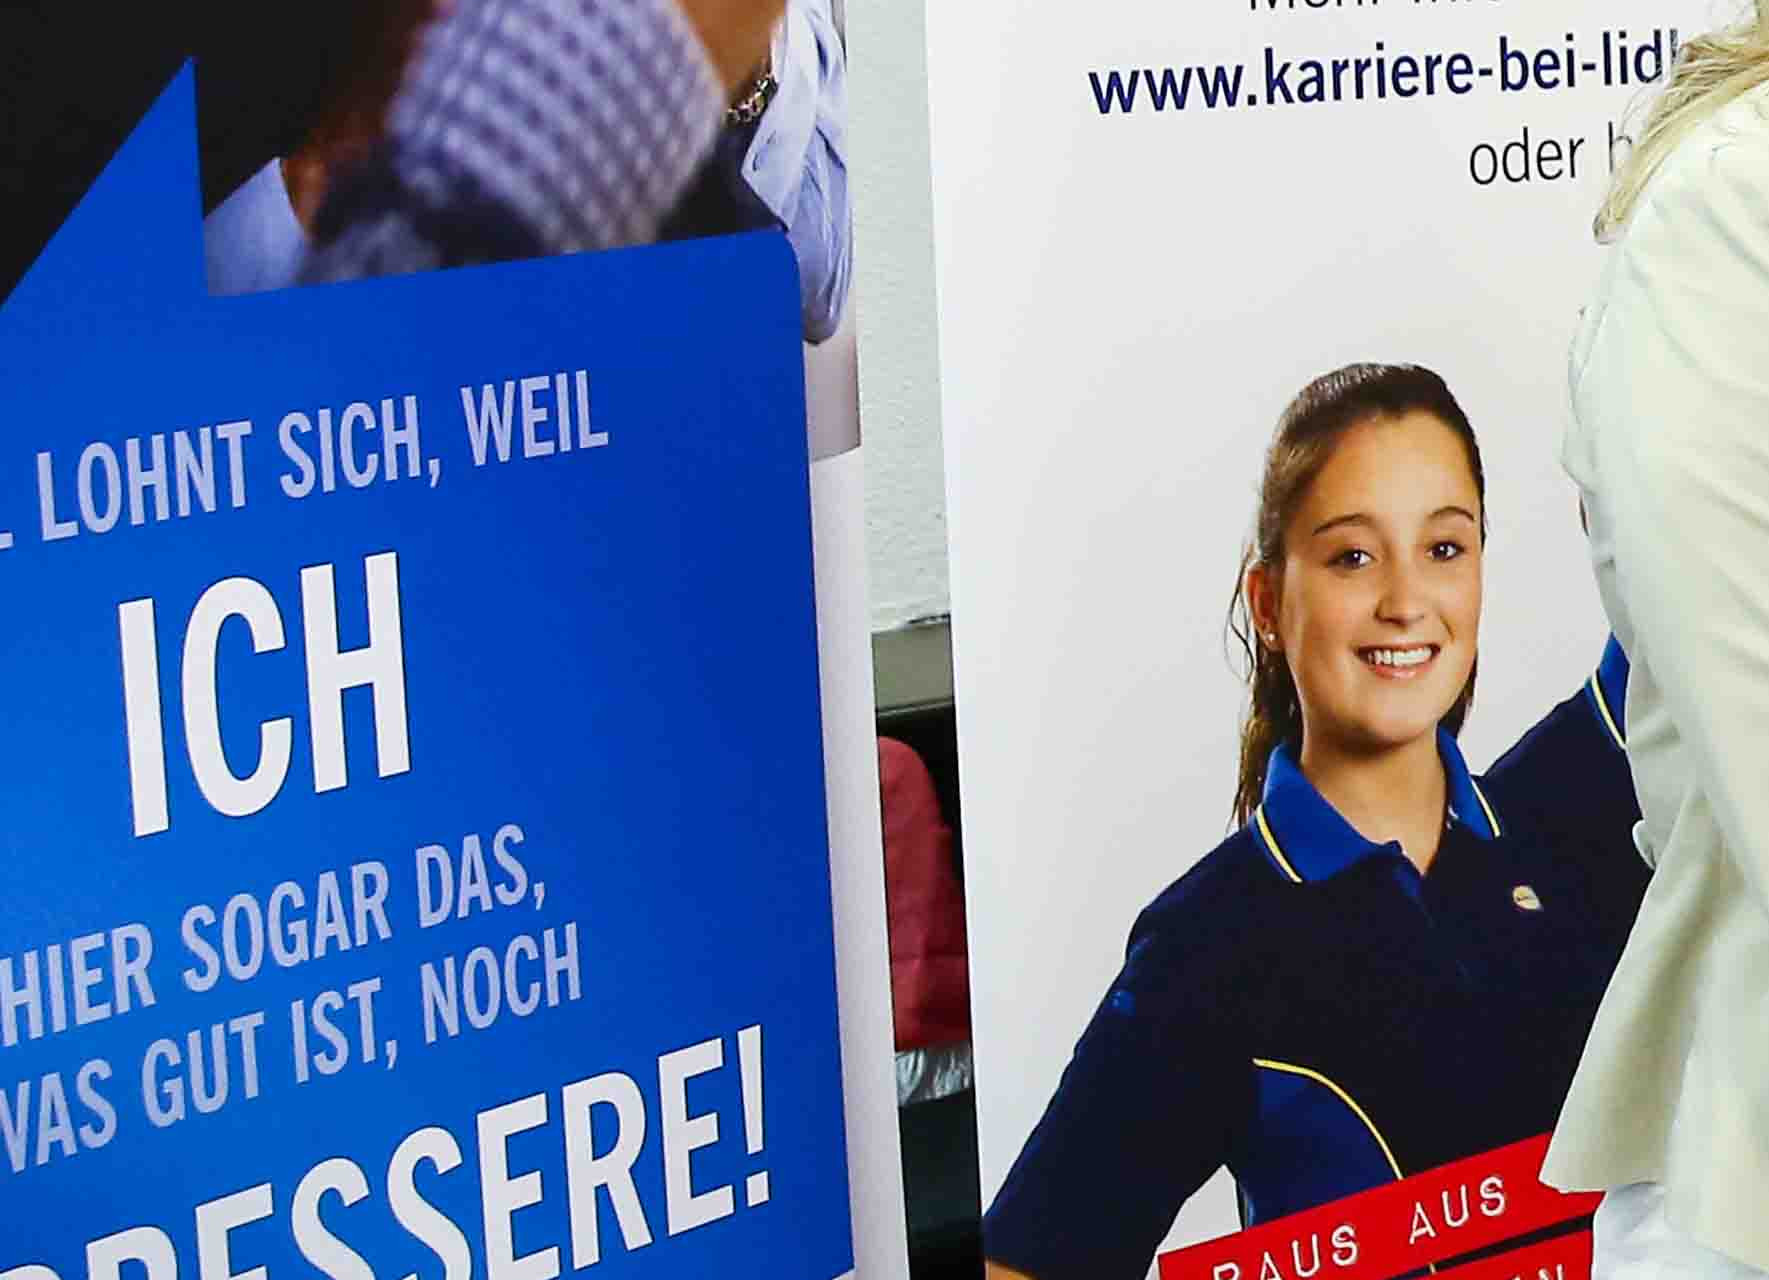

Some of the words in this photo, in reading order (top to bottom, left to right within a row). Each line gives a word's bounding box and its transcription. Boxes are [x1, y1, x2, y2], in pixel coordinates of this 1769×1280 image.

[1088, 27, 1679, 115] www.karriere-bei-lidl
[1468, 126, 1585, 188] oder
[36, 419, 251, 542] LOHNT
[277, 393, 444, 501] SICH,
[461, 368, 610, 467] WEIL
[117, 550, 412, 838] ICH
[0, 922, 155, 1048] HIER
[181, 860, 391, 992] SOGAR
[416, 823, 549, 929] DAS,
[142, 1009, 265, 1128] GUT
[291, 977, 399, 1086] IST,
[420, 922, 584, 1045] NOCH
[1408, 1174, 1508, 1246] AUS
